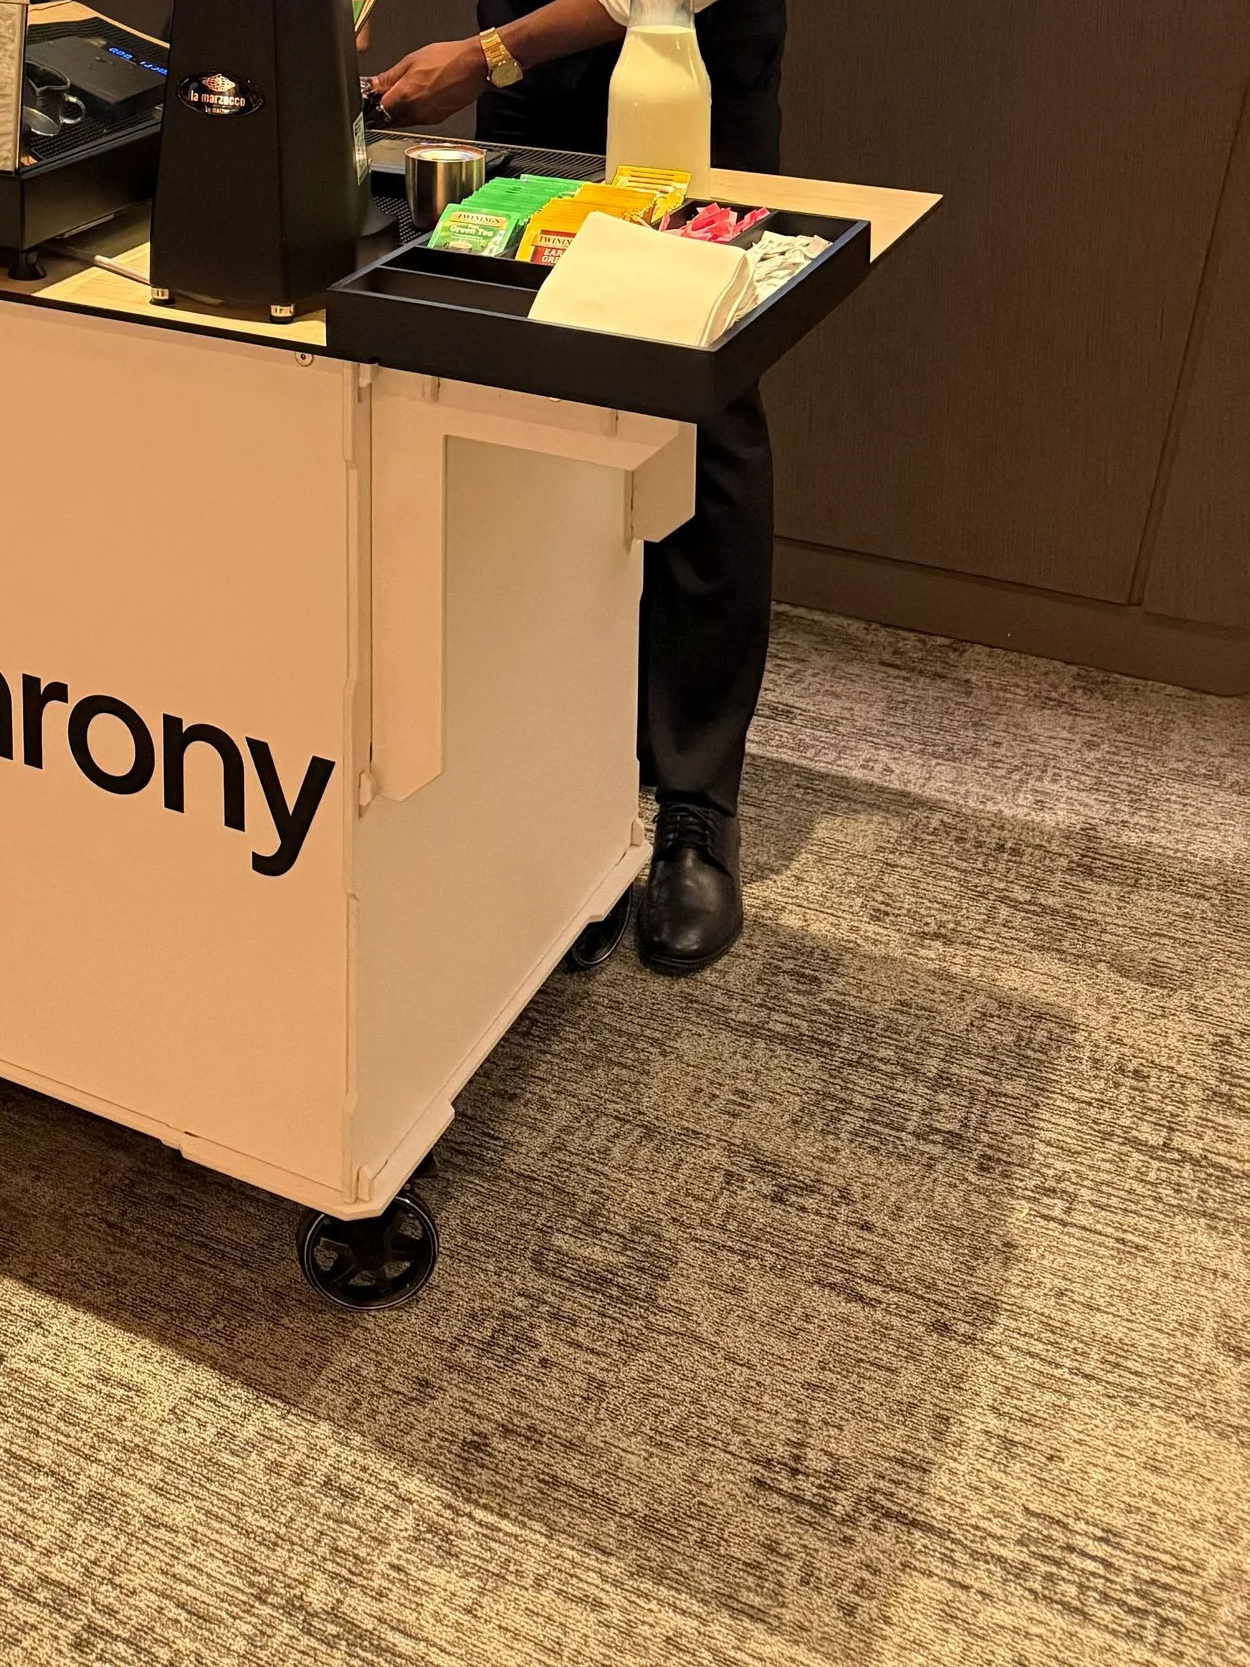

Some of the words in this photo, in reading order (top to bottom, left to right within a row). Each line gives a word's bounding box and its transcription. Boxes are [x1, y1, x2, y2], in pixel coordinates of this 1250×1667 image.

[190, 90, 199, 102] la
[201, 93, 246, 107] marzocco
[457, 214, 501, 224] TWININGS
[540, 235, 572, 245] TWININ
[544, 248, 563, 257] EAR
